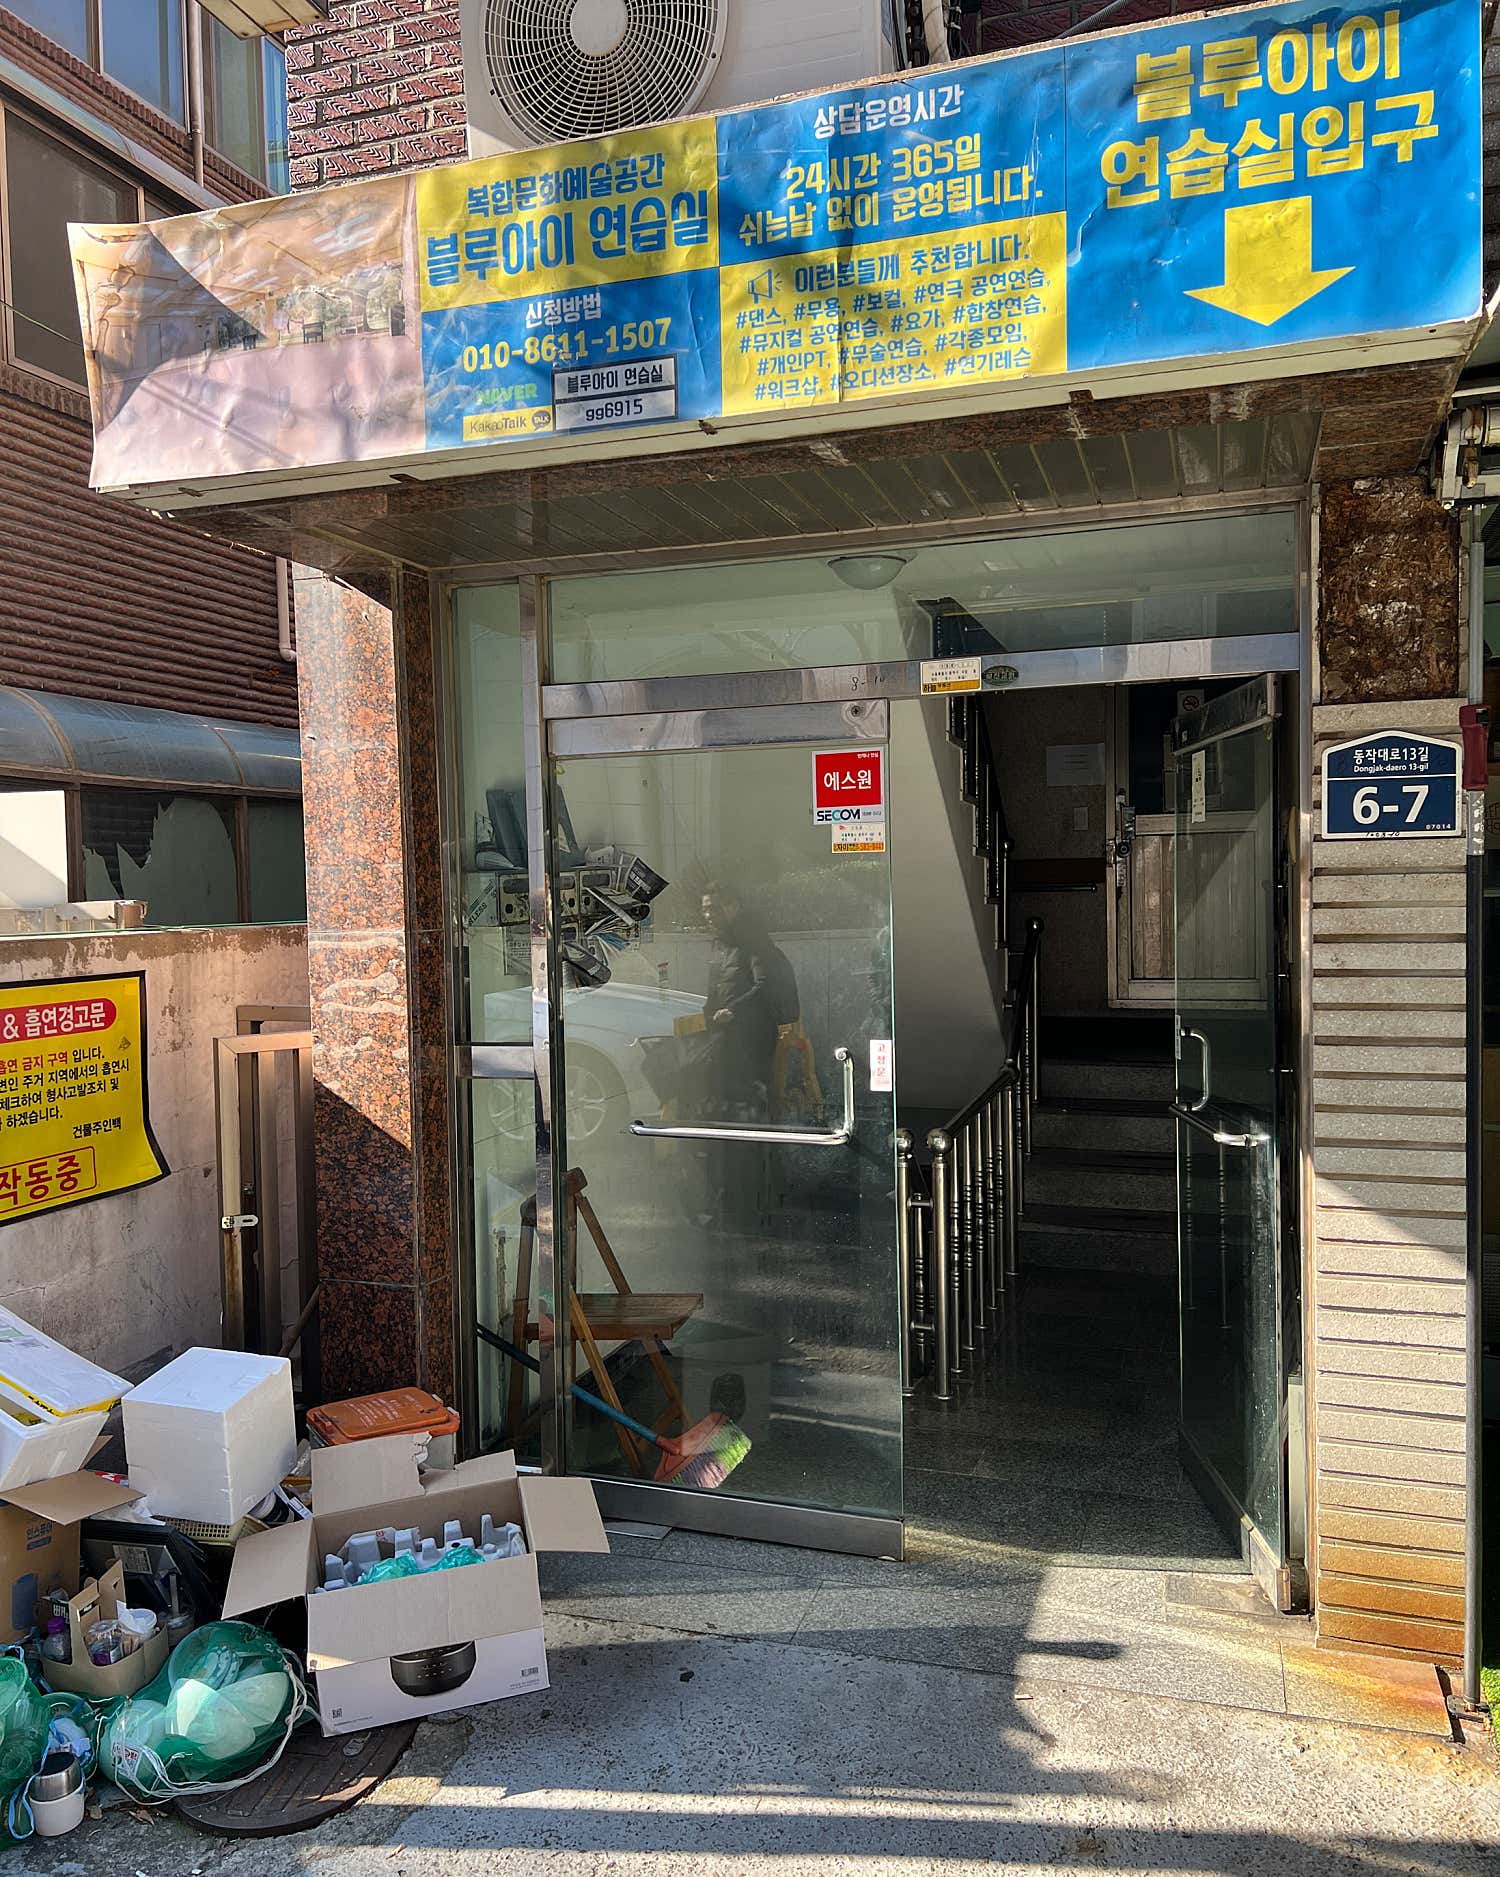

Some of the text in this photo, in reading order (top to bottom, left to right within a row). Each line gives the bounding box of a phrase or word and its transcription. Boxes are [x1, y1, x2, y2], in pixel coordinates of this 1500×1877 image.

[1133, 9, 1401, 123] 블루아이
[813, 84, 965, 140] 상담운영시간
[786, 133, 981, 200] 24시간 365일
[1100, 90, 1439, 209] 연습실입구
[467, 153, 665, 218] 복합문화예술공간
[739, 165, 1043, 247] 쉬는날 없이 운영됩니다.
[427, 190, 709, 287] 블루아이 연습실
[795, 234, 1030, 293] 이런분들께 추천합니다.
[525, 291, 601, 328] 신청방법
[736, 267, 1051, 330] #댄스, #무용, #보컬, #연극 공연연습,
[740, 294, 1046, 353] #뮤지컬 공연연습, #요가, #합창연습,
[463, 317, 672, 372] 010-8611-1507
[757, 322, 1027, 376] #개인PT, #무술연습, #각종모임,
[567, 363, 663, 393] 블루아이 연습실
[755, 347, 1031, 400] #워크샵, #오디션장소, #연기레슨
[476, 383, 538, 405] NAVER
[586, 399, 643, 421] gg6915
[470, 414, 526, 433] KakaoTalk
[1353, 746, 1429, 765] 동작대로13길
[1353, 762, 1429, 774] Dongjak-daero 13-gil
[823, 769, 872, 791] 에스원
[816, 808, 860, 822] SECOM
[1353, 785, 1429, 825] 6-7
[3, 1001, 106, 1040] & 흡연경고문
[22, 1054, 43, 1071] 금지
[47, 1051, 68, 1067] 구역
[72, 1046, 105, 1063] 입니다.
[22, 1072, 43, 1089] 주거
[48, 1064, 98, 1084] 지역에서의
[101, 1058, 129, 1075] 흡연시
[46, 1079, 106, 1103] 형사고발조치
[110, 1077, 119, 1091] 및
[6, 1105, 63, 1128] 하겠습니다.
[72, 1116, 122, 1139] 건물주인백
